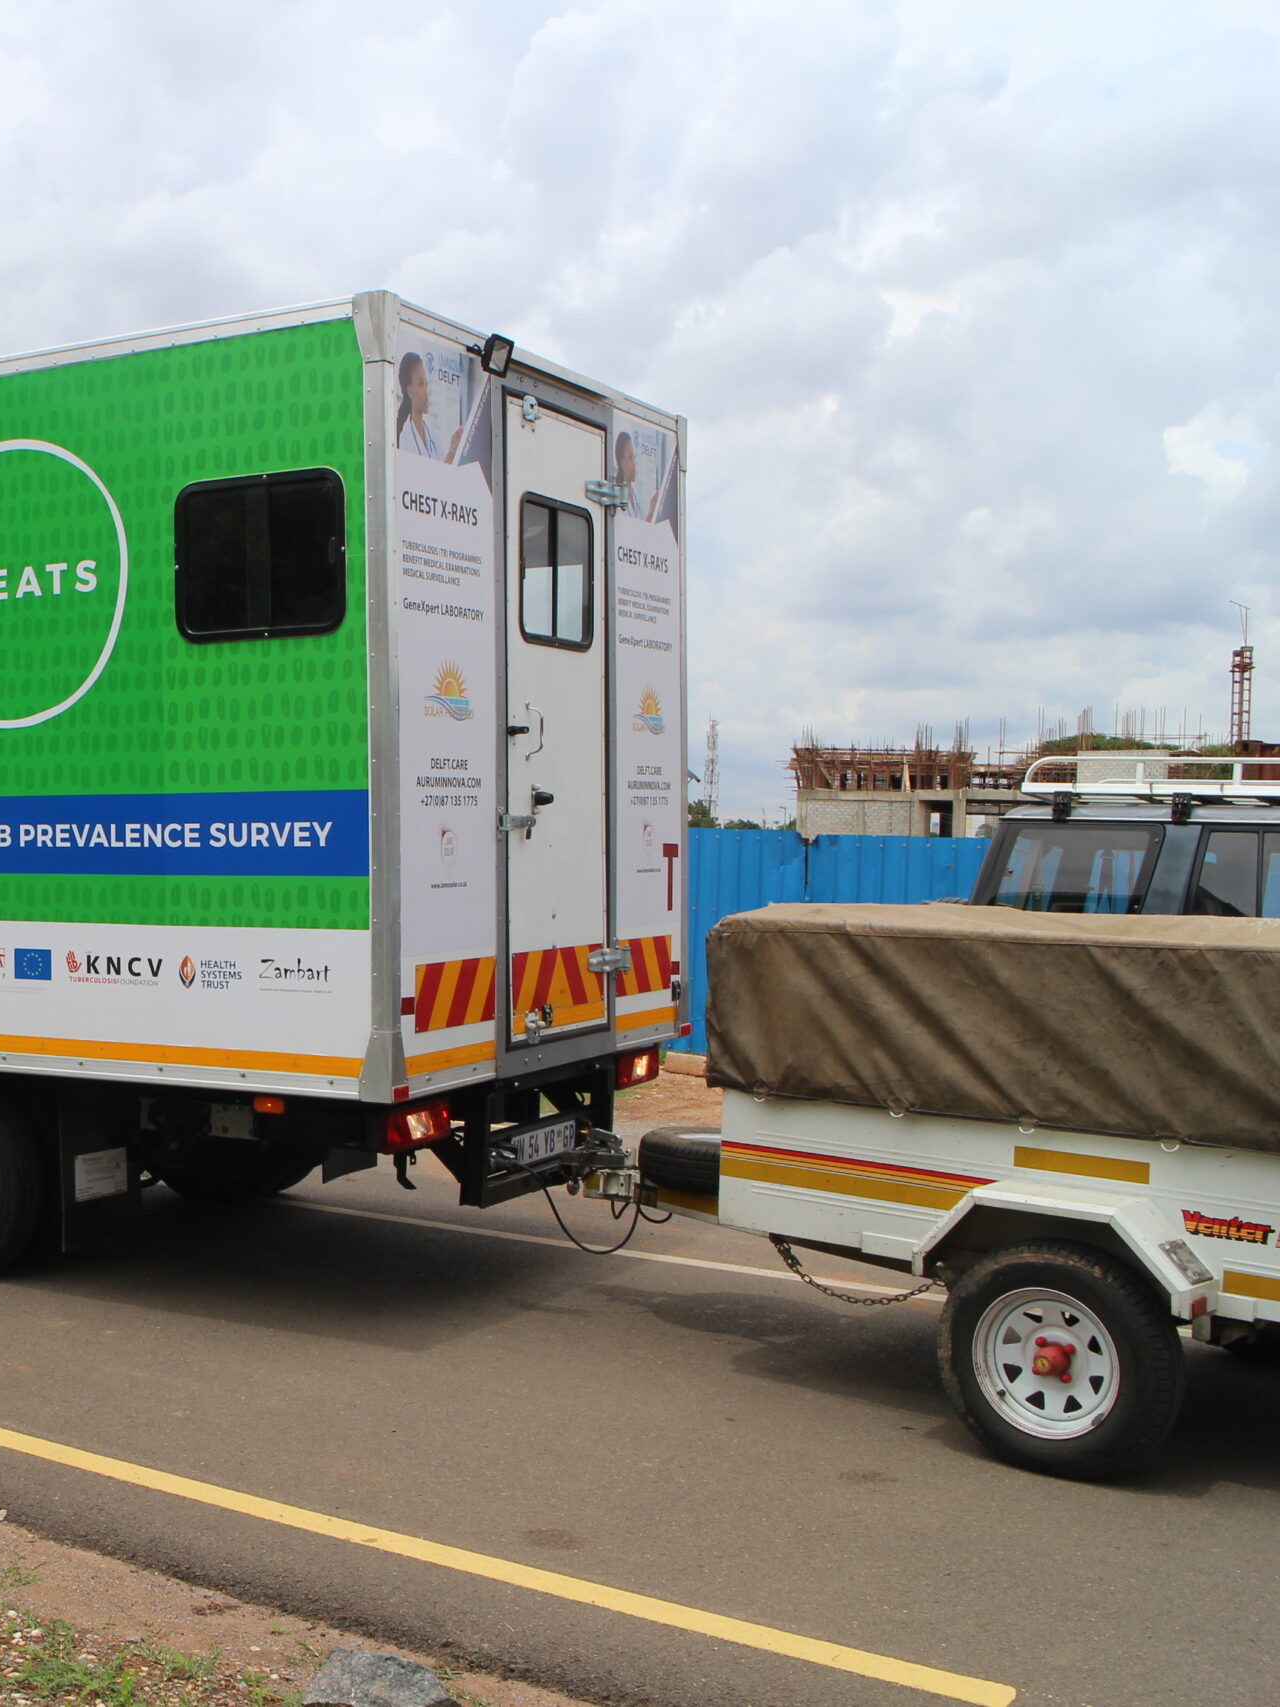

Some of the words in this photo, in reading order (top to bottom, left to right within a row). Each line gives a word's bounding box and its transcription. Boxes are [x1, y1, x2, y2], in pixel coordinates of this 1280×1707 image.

[438, 369, 460, 387] DELFT
[402, 491, 438, 516] CHEST
[440, 500, 478, 526] X-RAYS
[402, 540, 439, 556] TUBERCULOSIS
[449, 550, 482, 565] PROGRAMMES
[617, 546, 641, 566] CHEST
[643, 553, 668, 573] X-RAYS
[402, 553, 422, 566] BENEFIT
[423, 558, 445, 571] MEDICAL
[445, 562, 480, 577] EXAMINATIONS
[402, 567, 425, 580] MEDICAL
[425, 571, 460, 586] SURVEILLANCE
[402, 597, 440, 616] GeneXpert
[441, 603, 484, 621] LABORATORY
[431, 758, 468, 770] DELFT.CARE
[636, 765, 662, 776] DELFT.CARE
[416, 776, 482, 788] AURUMINNOVA.COM
[420, 795, 448, 808] +27(0)87
[450, 796, 462, 807] 135
[463, 796, 478, 807] 1775
[20, 823, 201, 848] PREVALENCE
[208, 821, 333, 848] SURVEY
[86, 954, 163, 978] KNCV
[200, 960, 237, 970] HEALTH
[200, 970, 243, 981] SYSTEMS
[259, 957, 332, 983] Zambart
[201, 980, 231, 990] TRUST
[528, 1134, 539, 1159] 54
[563, 1124, 575, 1148] GP
[1181, 1209, 1274, 1245] Venter
